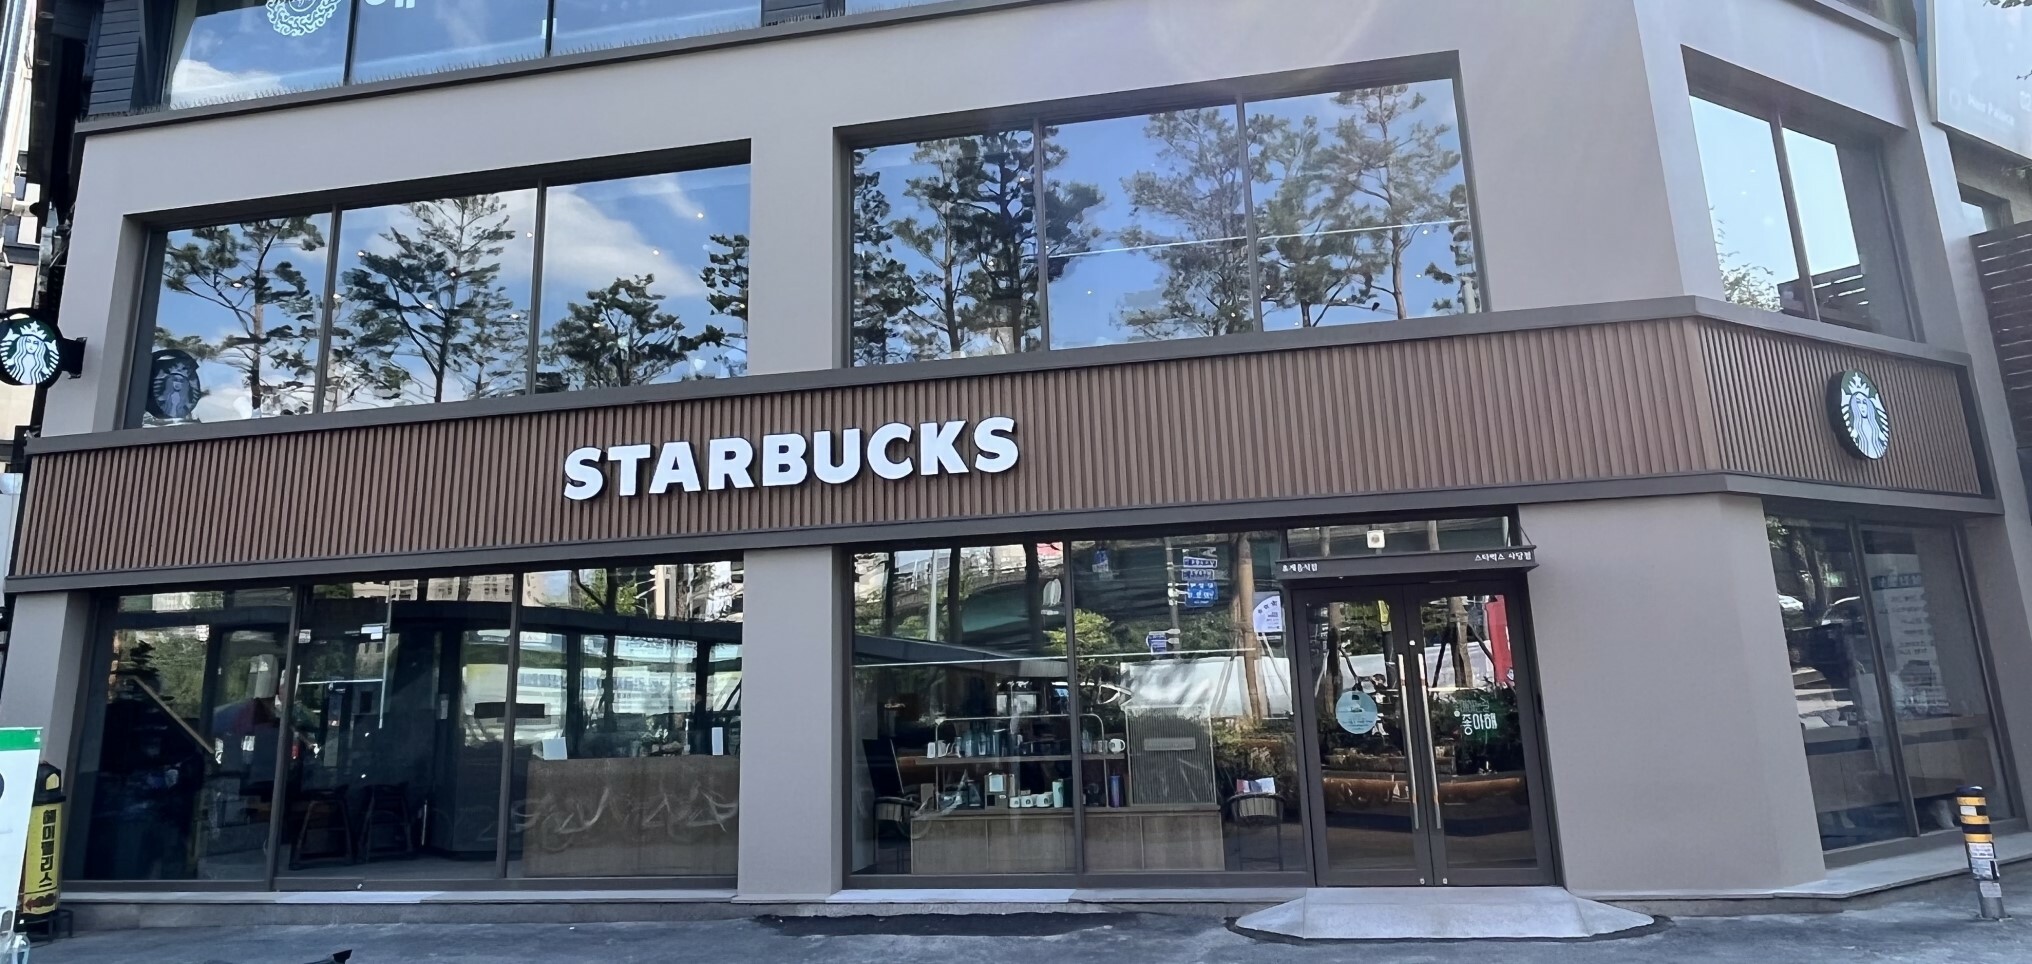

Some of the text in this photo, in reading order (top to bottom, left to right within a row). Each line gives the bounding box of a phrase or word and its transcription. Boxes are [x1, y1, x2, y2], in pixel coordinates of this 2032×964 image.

[563, 416, 1020, 500] STARBUCKS
[1474, 553, 1505, 562] 스타벅스
[1460, 712, 1498, 736] 좋아해
